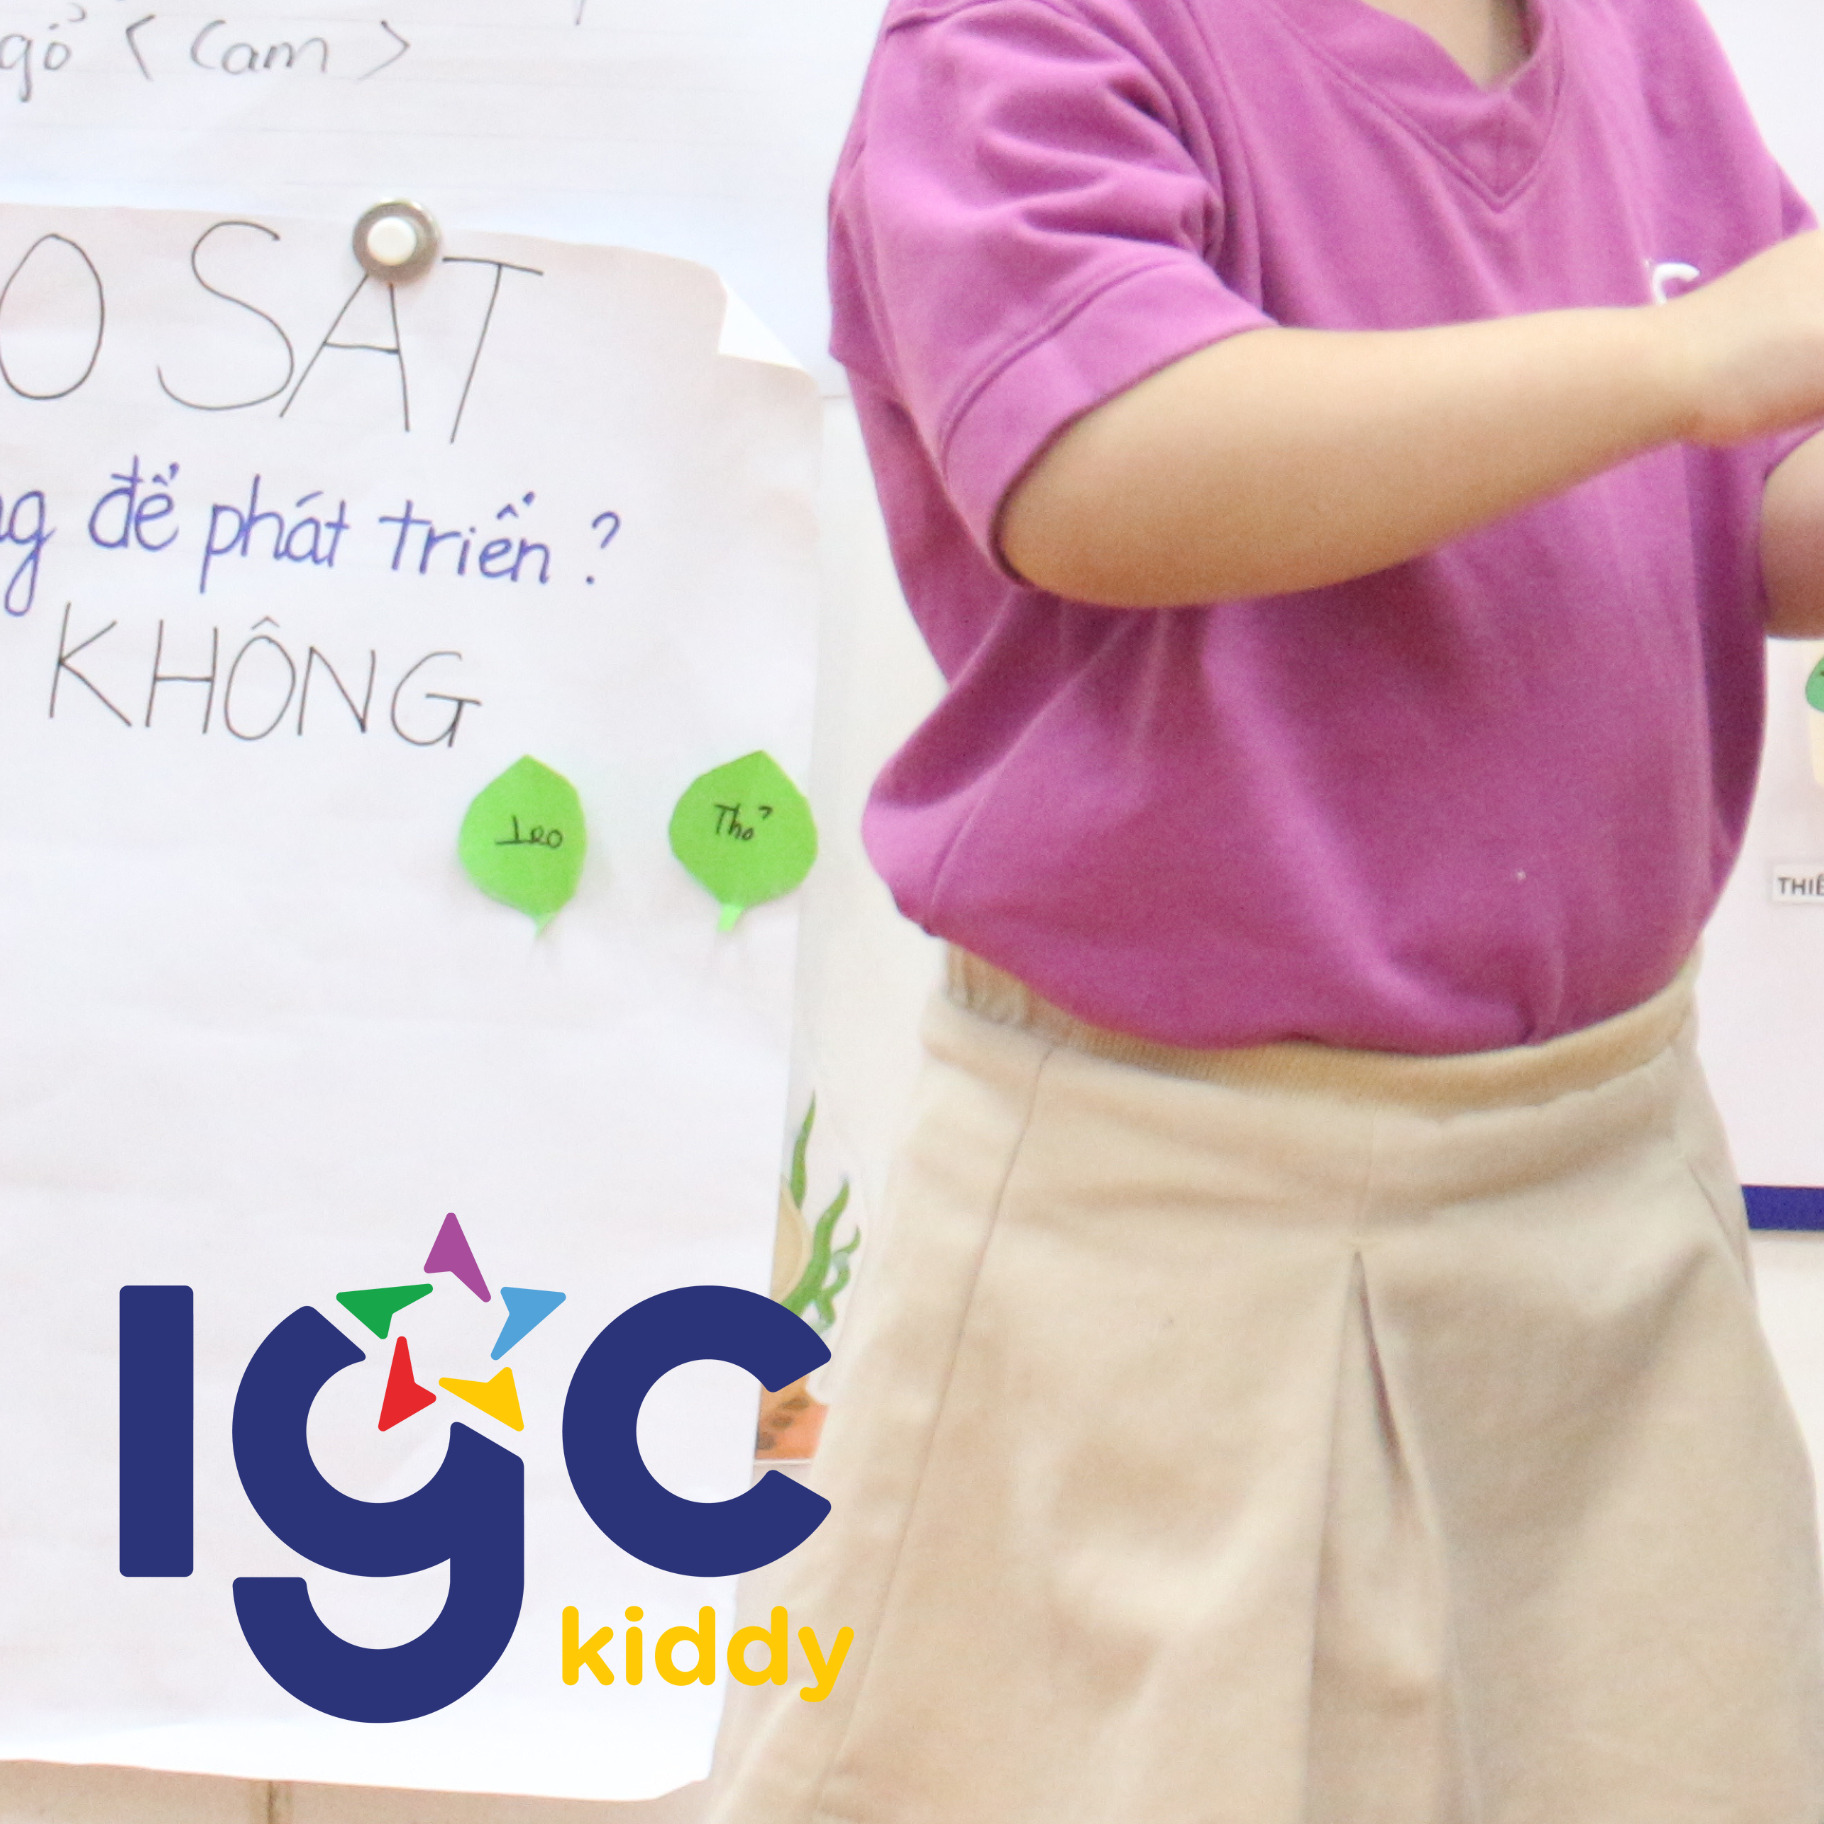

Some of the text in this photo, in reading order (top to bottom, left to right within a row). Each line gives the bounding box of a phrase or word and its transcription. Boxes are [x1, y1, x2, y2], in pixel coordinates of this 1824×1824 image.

[190, 18, 330, 75] Cam
[88, 454, 180, 552] để
[199, 473, 350, 594] phát
[49, 601, 482, 748] KHÔNG
